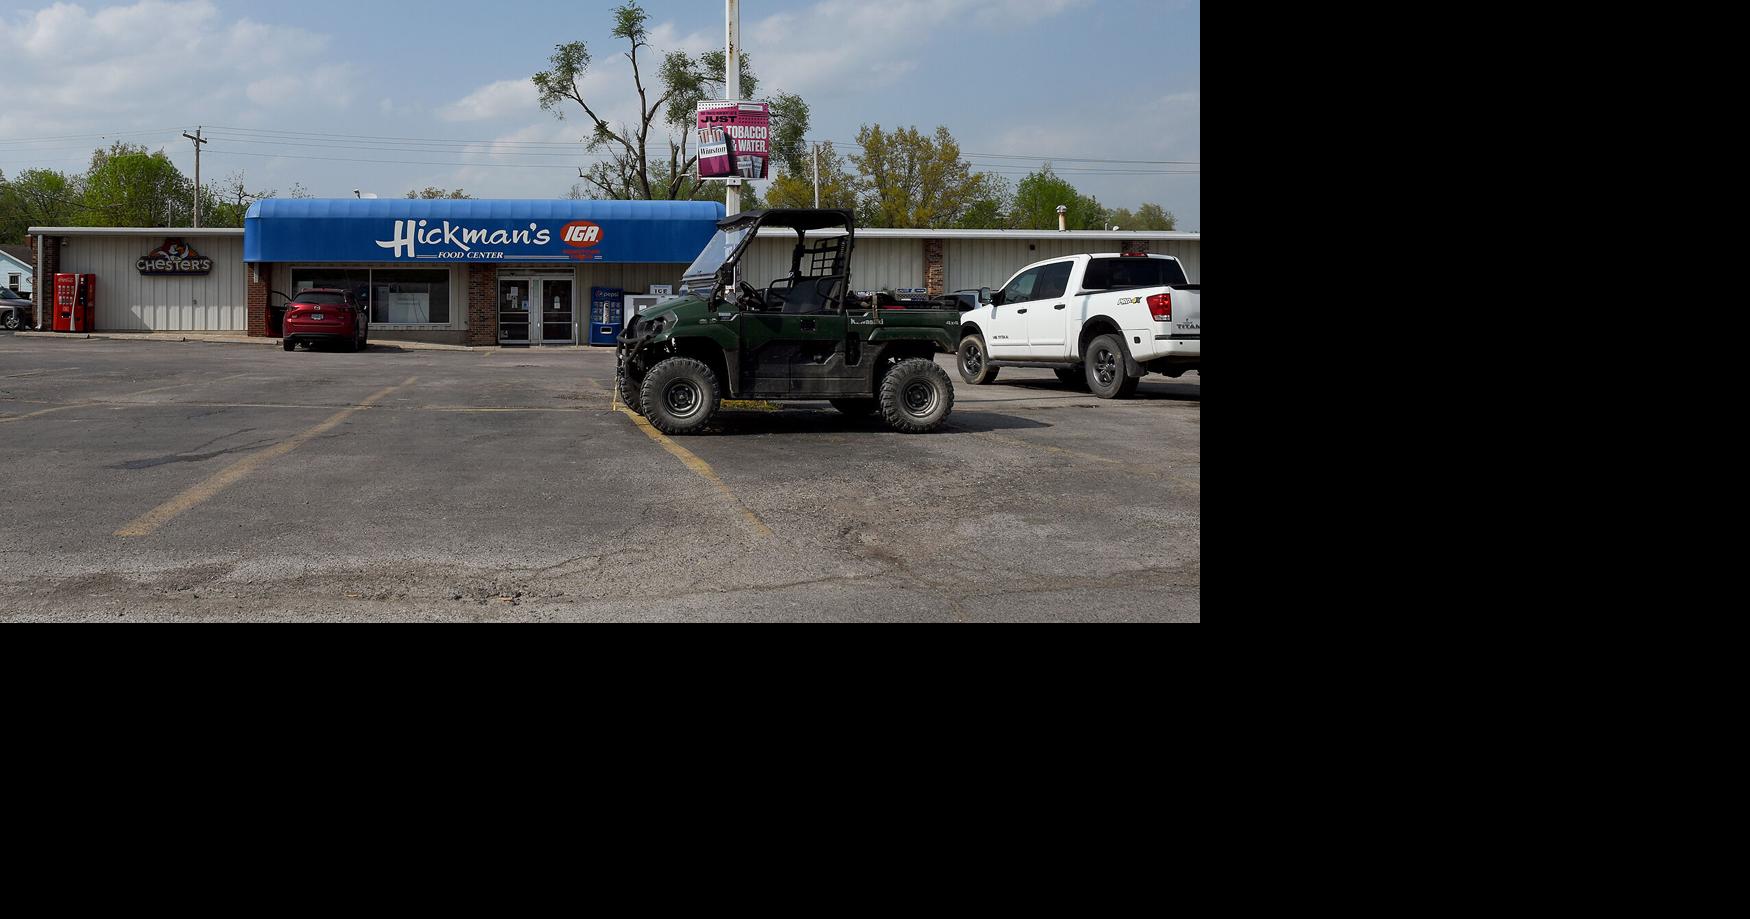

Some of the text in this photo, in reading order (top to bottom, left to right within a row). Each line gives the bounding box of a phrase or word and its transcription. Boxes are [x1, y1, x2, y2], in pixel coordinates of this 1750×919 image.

[701, 115, 737, 123] JUST
[726, 125, 767, 139] TOBACCO
[700, 146, 726, 155] Winston
[738, 140, 767, 152] WATER.
[375, 219, 551, 258] Hickman's
[564, 226, 600, 242] IGA
[438, 251, 504, 259] FOOD CENTER
